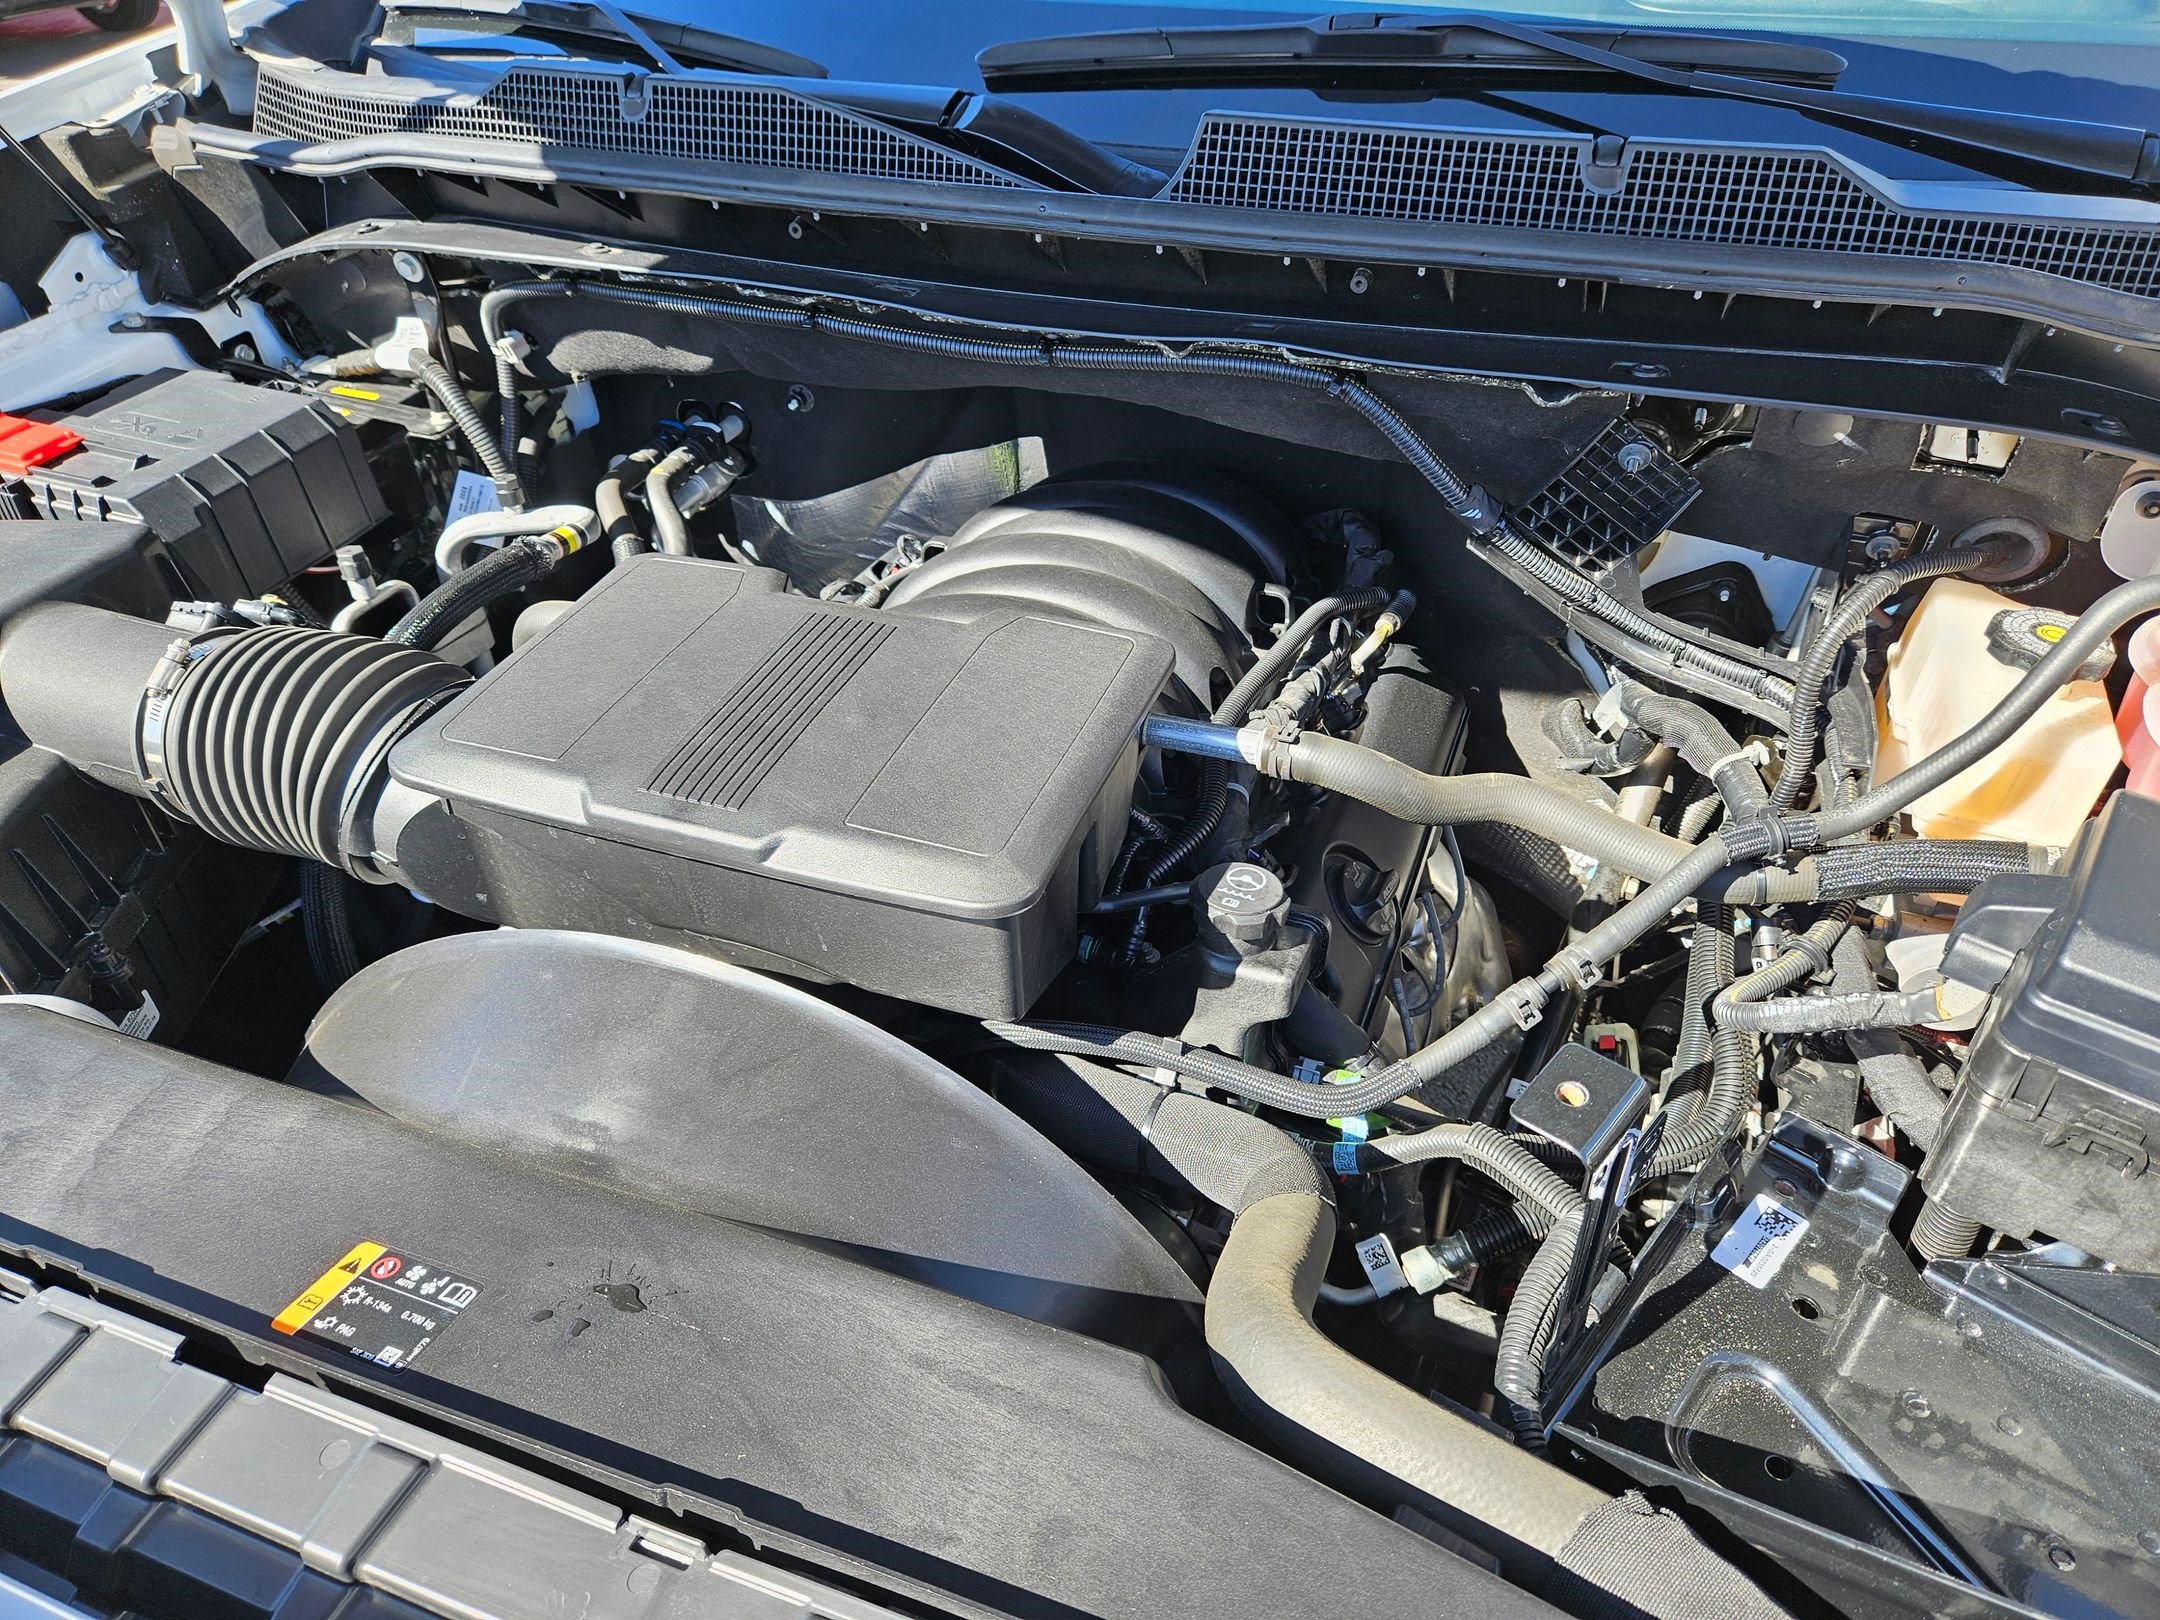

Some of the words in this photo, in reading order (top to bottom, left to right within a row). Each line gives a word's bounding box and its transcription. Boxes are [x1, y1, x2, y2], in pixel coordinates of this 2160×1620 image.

[395, 1278, 417, 1289] AUTO
[363, 1296, 392, 1313] R-134a
[401, 1310, 425, 1325] 0.700
[423, 1319, 436, 1330] kg
[335, 1323, 356, 1337] PAG
